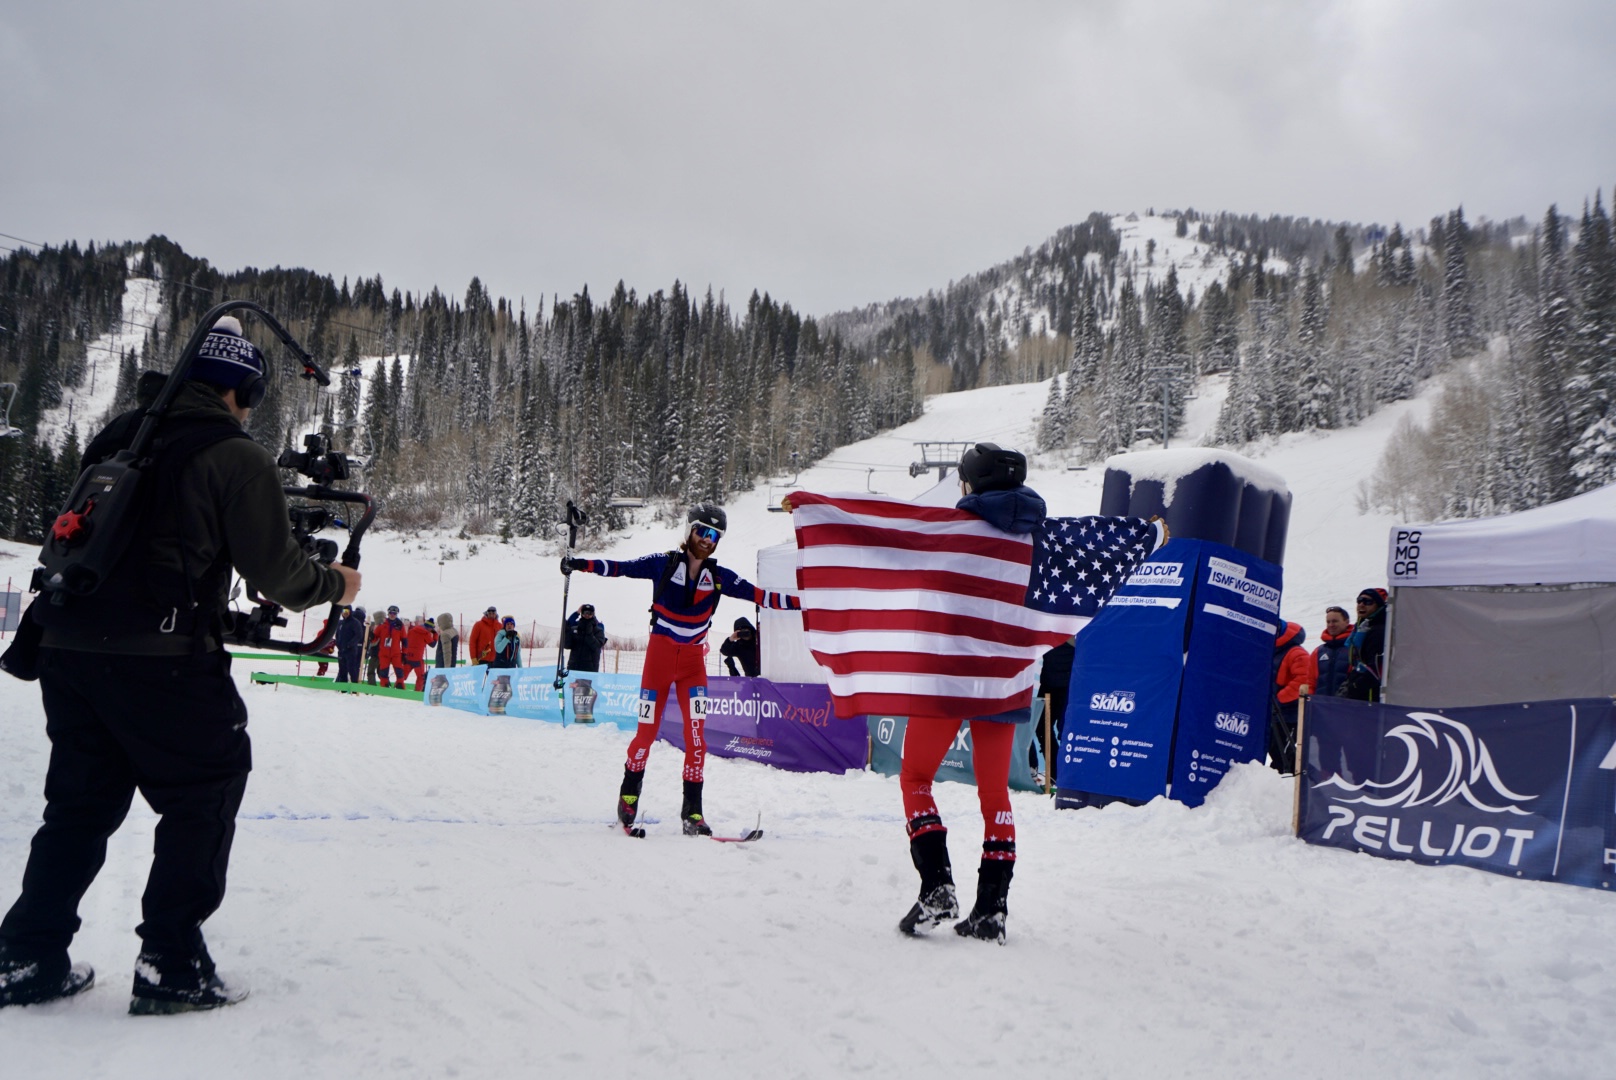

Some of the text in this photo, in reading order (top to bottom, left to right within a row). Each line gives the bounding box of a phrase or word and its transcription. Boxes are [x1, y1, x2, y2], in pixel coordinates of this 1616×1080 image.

[202, 342, 254, 359] BEFORE
[206, 336, 254, 351] PLANTS
[199, 349, 244, 362] PILLS.
[1397, 531, 1422, 545] PO
[1395, 546, 1420, 560] MO
[1153, 565, 1178, 576] CUP
[1393, 561, 1418, 575] CA
[1212, 571, 1279, 602] ISMF WORLD CUP
[517, 683, 552, 701] RE-LYTE
[694, 700, 708, 715] 8.2
[706, 691, 783, 725] azerbaijan
[1091, 694, 1134, 712] SkiMo
[1215, 713, 1249, 735] SkiMo
[1322, 805, 1535, 866] PELLIOT
